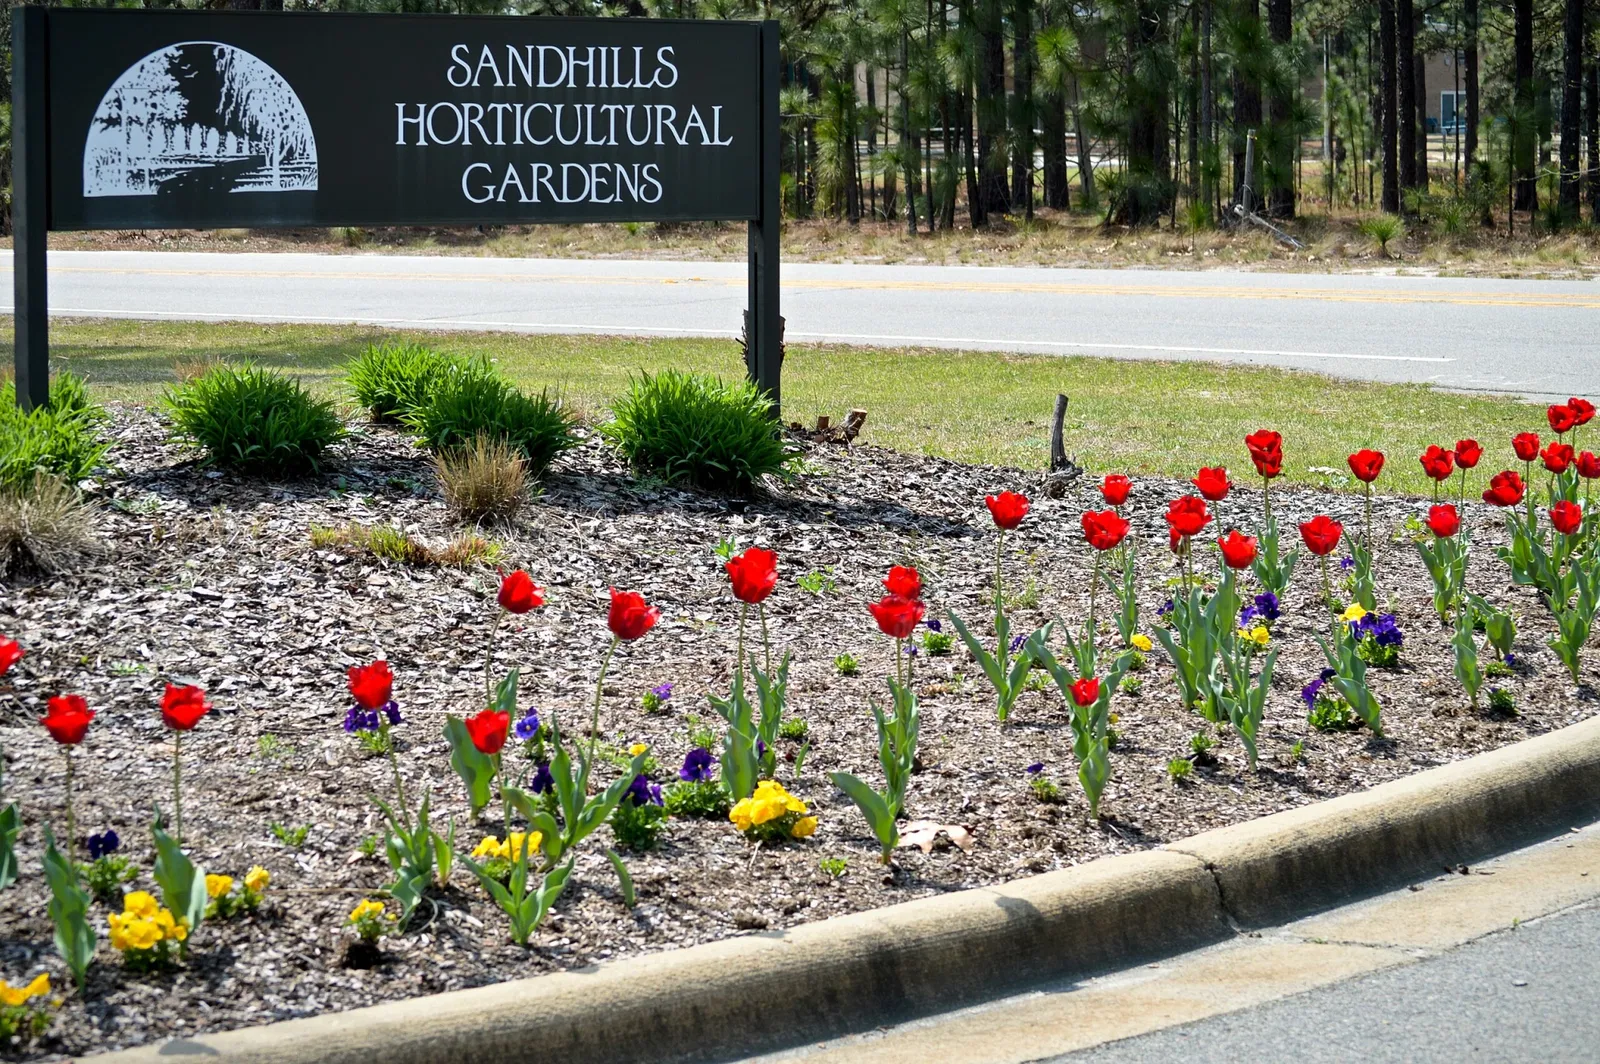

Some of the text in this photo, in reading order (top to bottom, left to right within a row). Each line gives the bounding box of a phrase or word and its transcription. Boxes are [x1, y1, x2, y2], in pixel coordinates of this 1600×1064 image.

[446, 44, 679, 89] SANDHILLS
[394, 102, 734, 147] HORTICULTURAL
[461, 162, 663, 204] GARDENS
